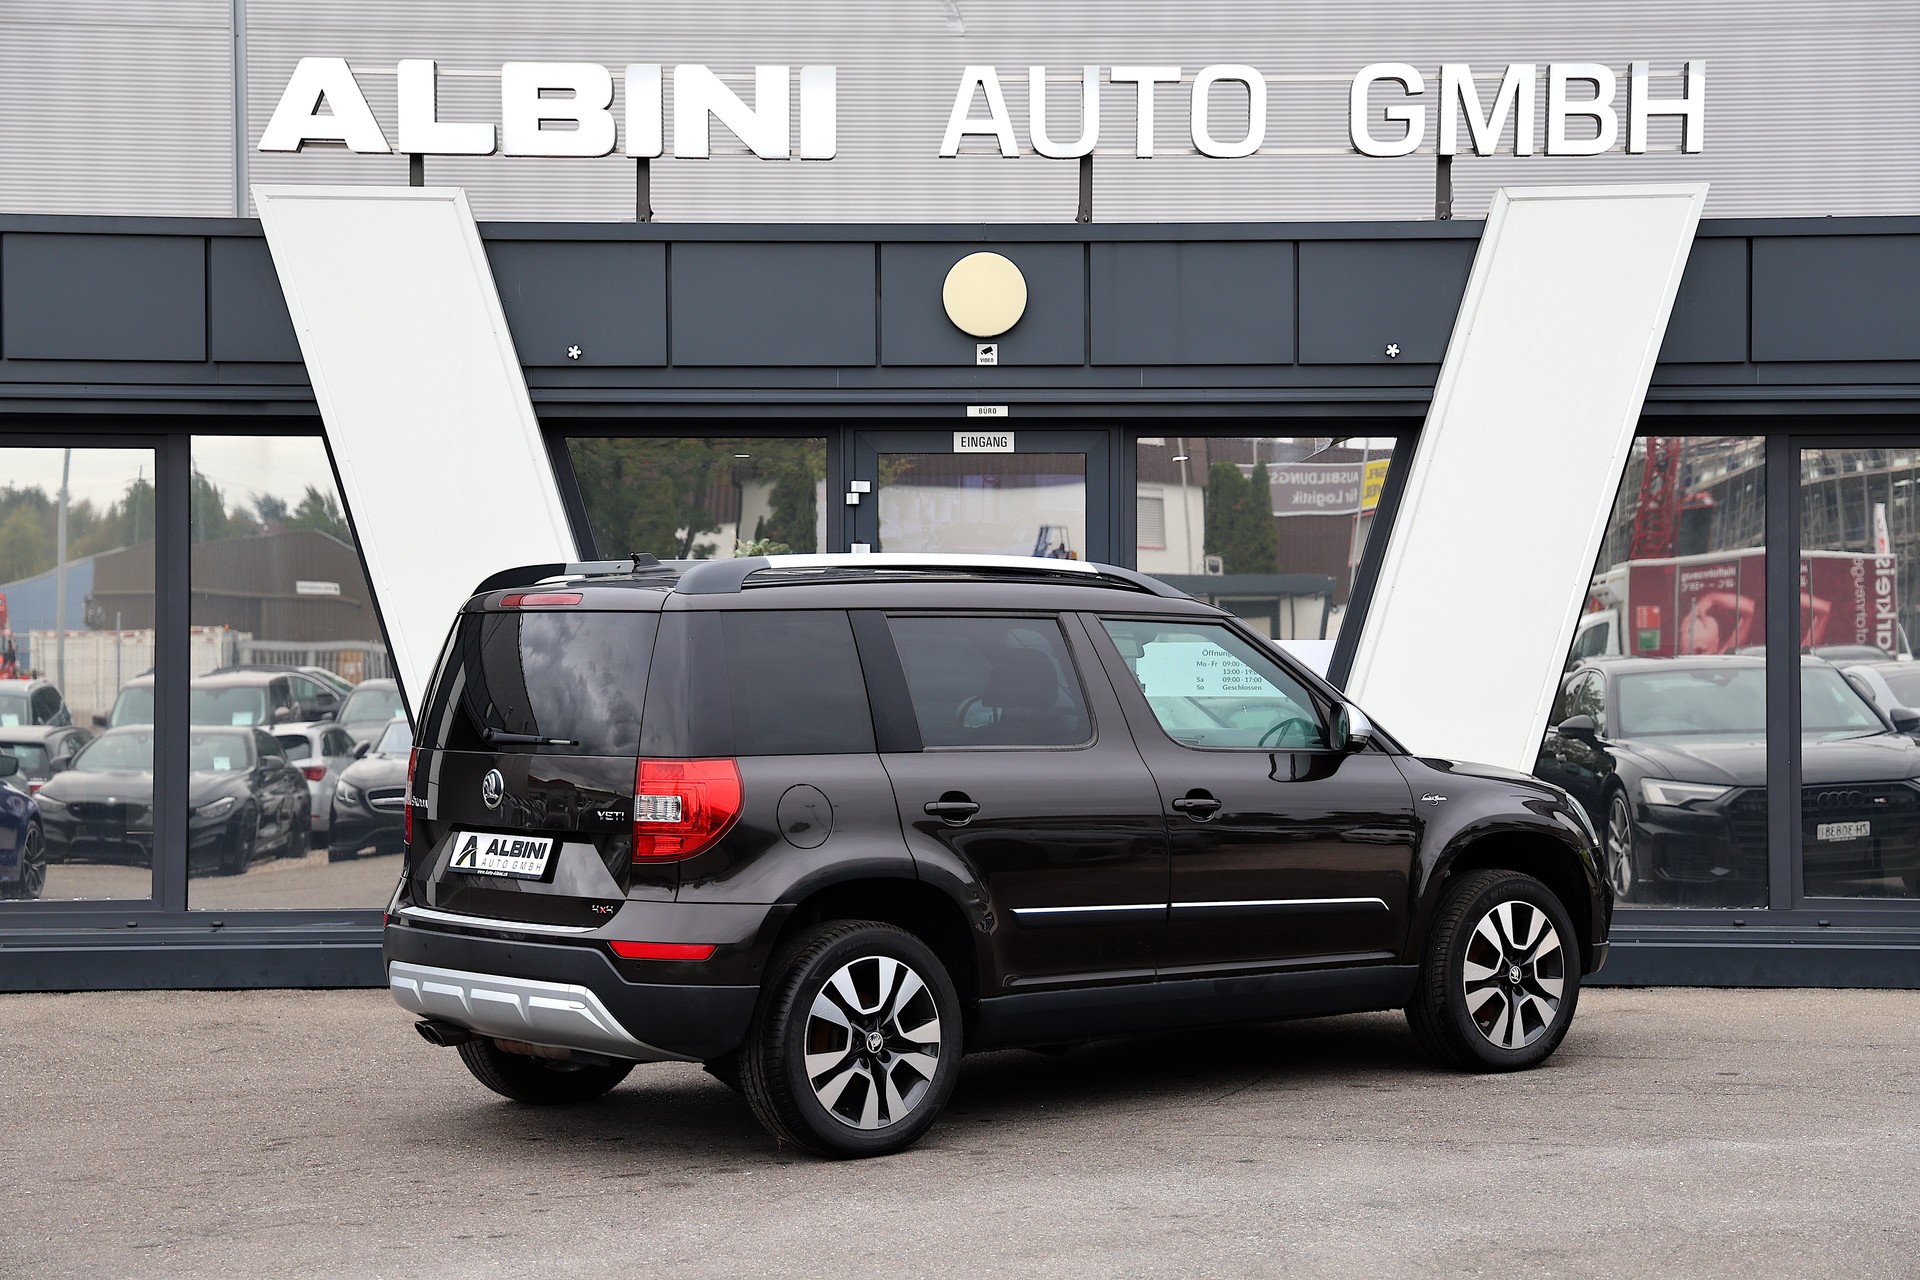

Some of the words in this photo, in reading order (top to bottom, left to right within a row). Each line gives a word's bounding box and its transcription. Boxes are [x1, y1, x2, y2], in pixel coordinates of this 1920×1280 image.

[257, 56, 838, 161] ALBINI
[938, 62, 1268, 159] AUTO
[1348, 58, 1706, 157] GMBH
[978, 406, 997, 415] BÜRO
[960, 436, 1008, 448] EINGANG
[597, 810, 625, 821] YETI
[485, 838, 548, 860] ALBINI
[481, 858, 509, 868] AUTO
[512, 860, 542, 872] GMBH
